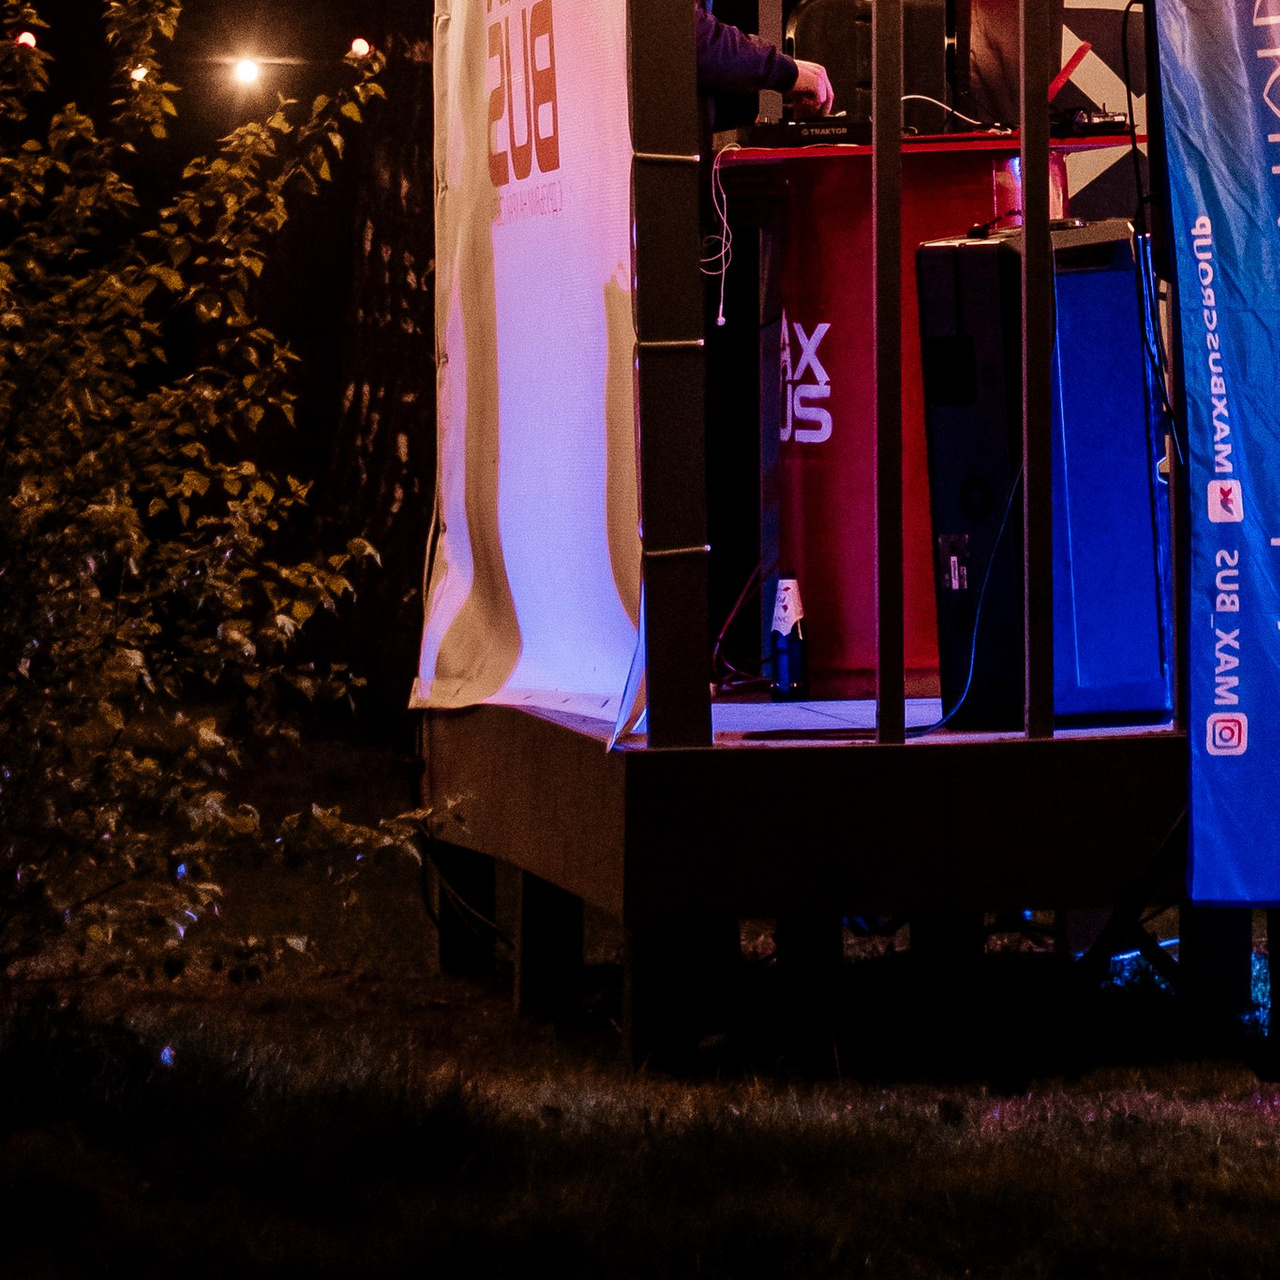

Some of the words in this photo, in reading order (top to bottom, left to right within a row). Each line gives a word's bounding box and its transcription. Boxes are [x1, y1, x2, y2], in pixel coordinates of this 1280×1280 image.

[810, 128, 848, 136] TRAKTOR
[779, 307, 831, 381] AX
[779, 382, 833, 443] US
